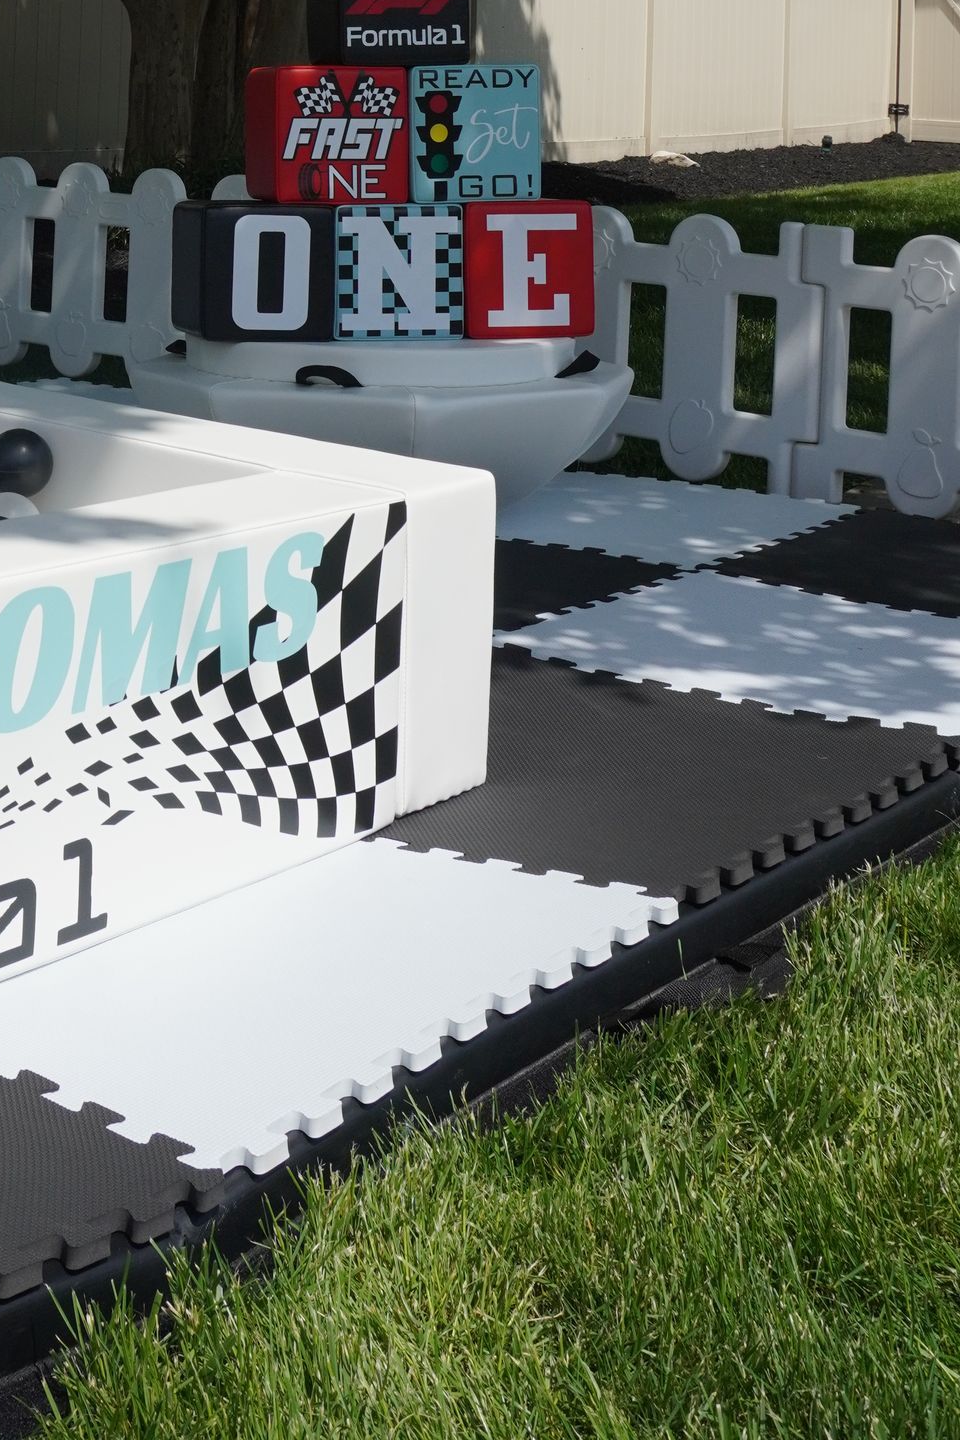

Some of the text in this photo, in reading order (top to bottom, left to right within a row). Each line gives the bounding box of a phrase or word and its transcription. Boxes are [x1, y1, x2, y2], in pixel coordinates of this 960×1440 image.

[419, 69, 535, 89] READY
[282, 117, 403, 160] FAST
[466, 103, 538, 164] Set
[458, 174, 533, 198] GO!
